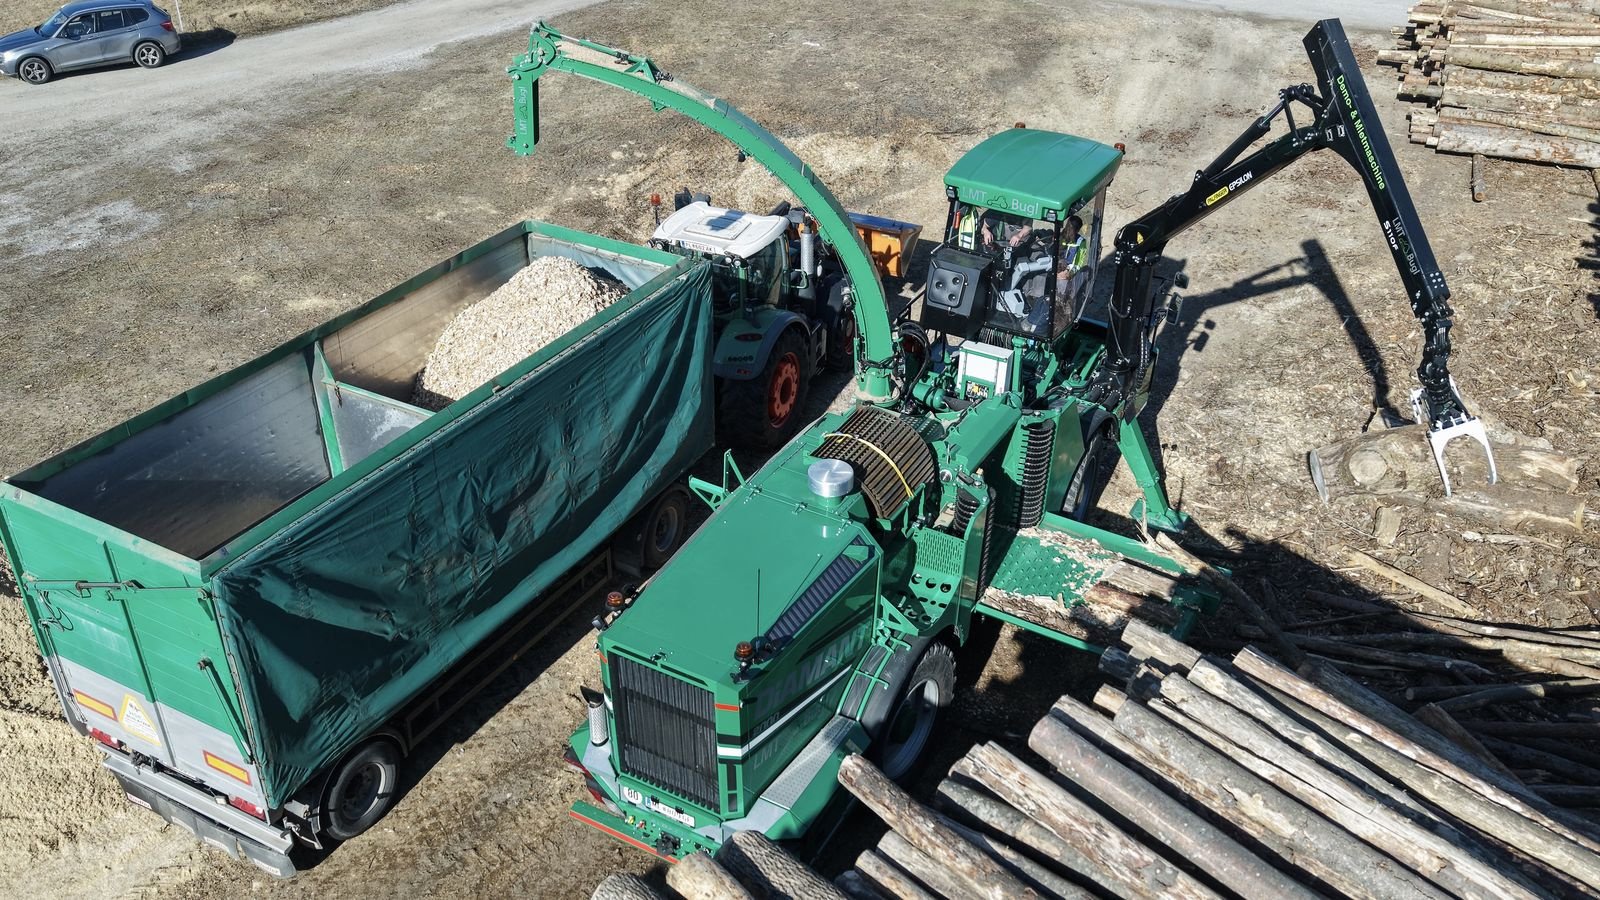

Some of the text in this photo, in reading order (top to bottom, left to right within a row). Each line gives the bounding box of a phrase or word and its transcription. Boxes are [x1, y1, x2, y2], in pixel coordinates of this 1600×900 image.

[518, 86, 528, 135] LMT Bugl
[1336, 74, 1385, 190] Demo- & Mietmaschine
[962, 186, 1039, 216] LMT Bugl
[1228, 170, 1253, 191] EPSILON
[1392, 217, 1421, 275] LMT Bugl
